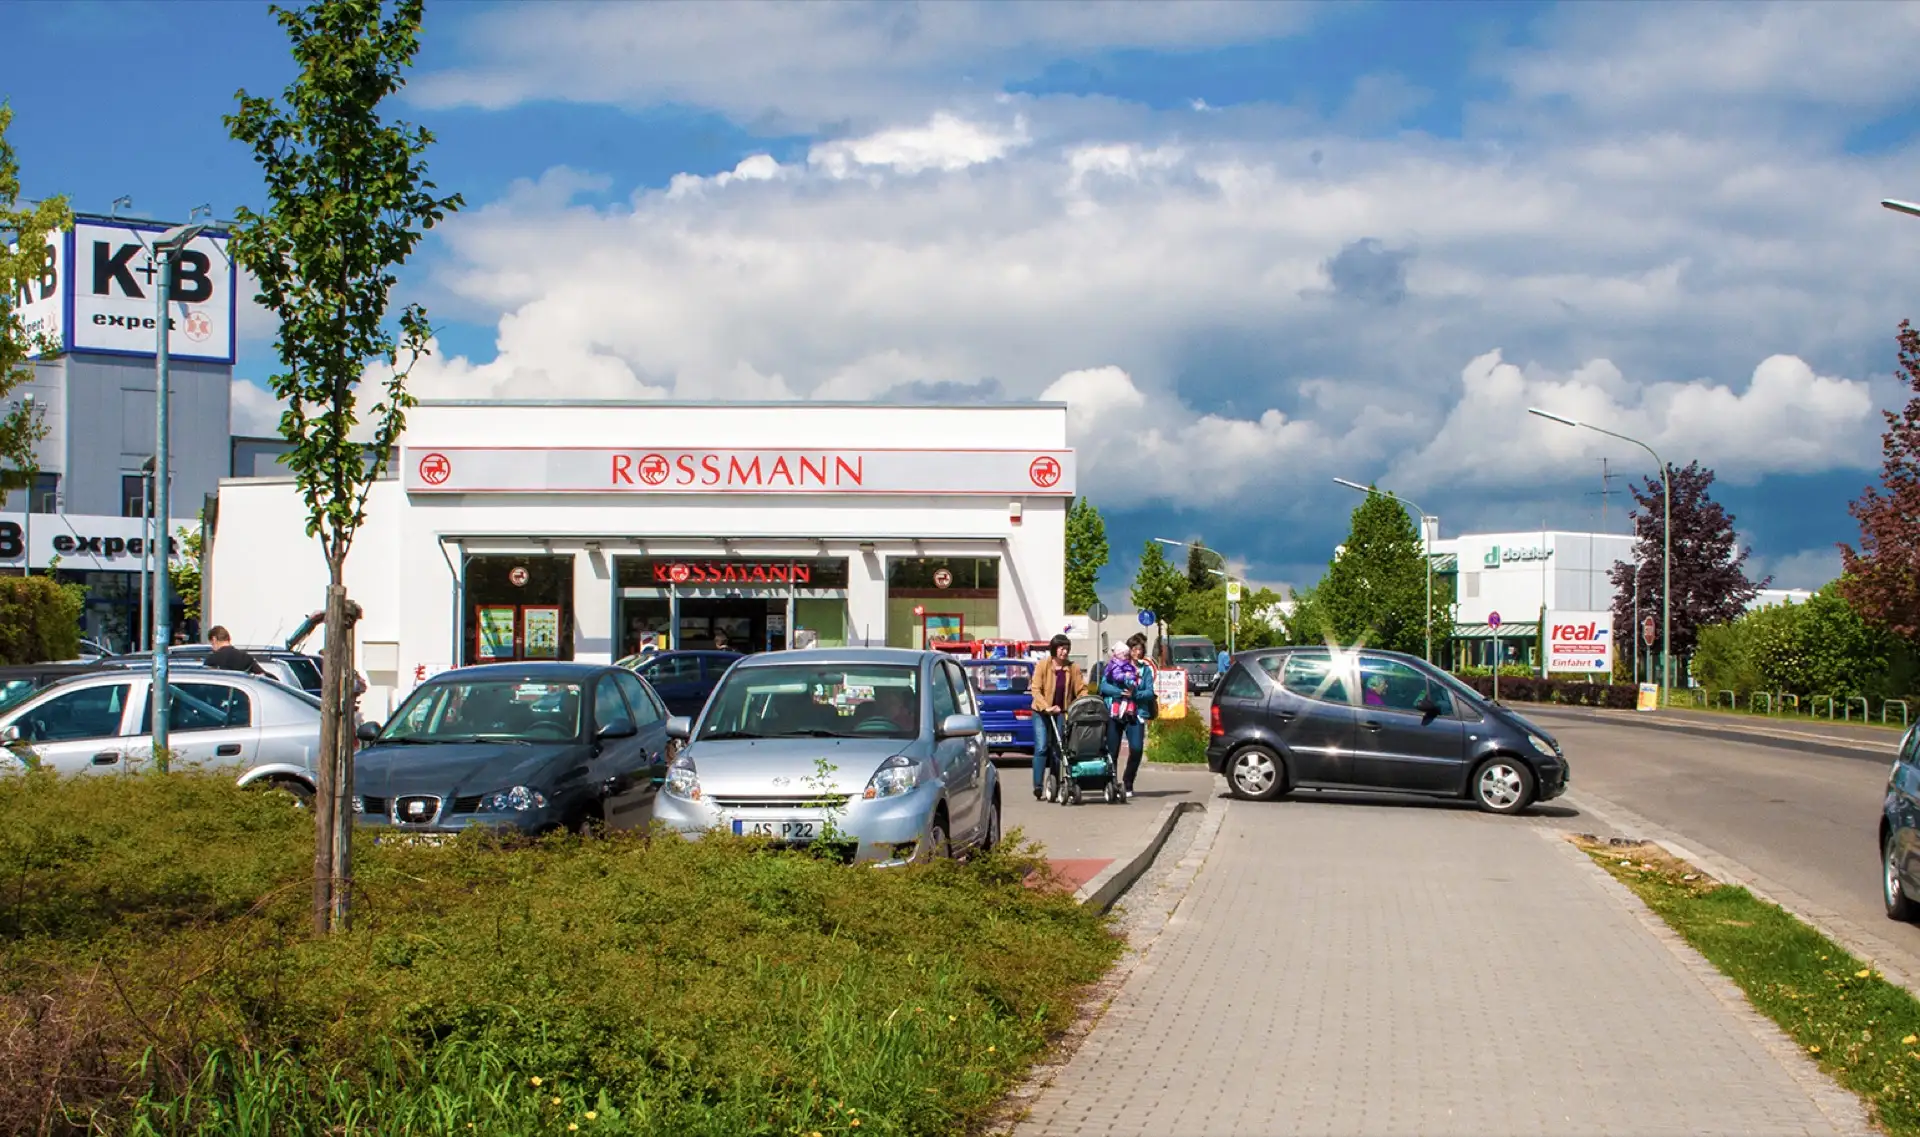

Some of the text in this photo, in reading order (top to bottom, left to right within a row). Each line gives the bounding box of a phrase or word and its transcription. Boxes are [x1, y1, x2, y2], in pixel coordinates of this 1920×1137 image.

[93, 313, 176, 330] expet
[611, 453, 863, 486] ROSSMANN
[653, 563, 810, 583] ROSSMANN
[1552, 659, 1591, 667] Einfahrt
[754, 823, 813, 838] AS P 22
